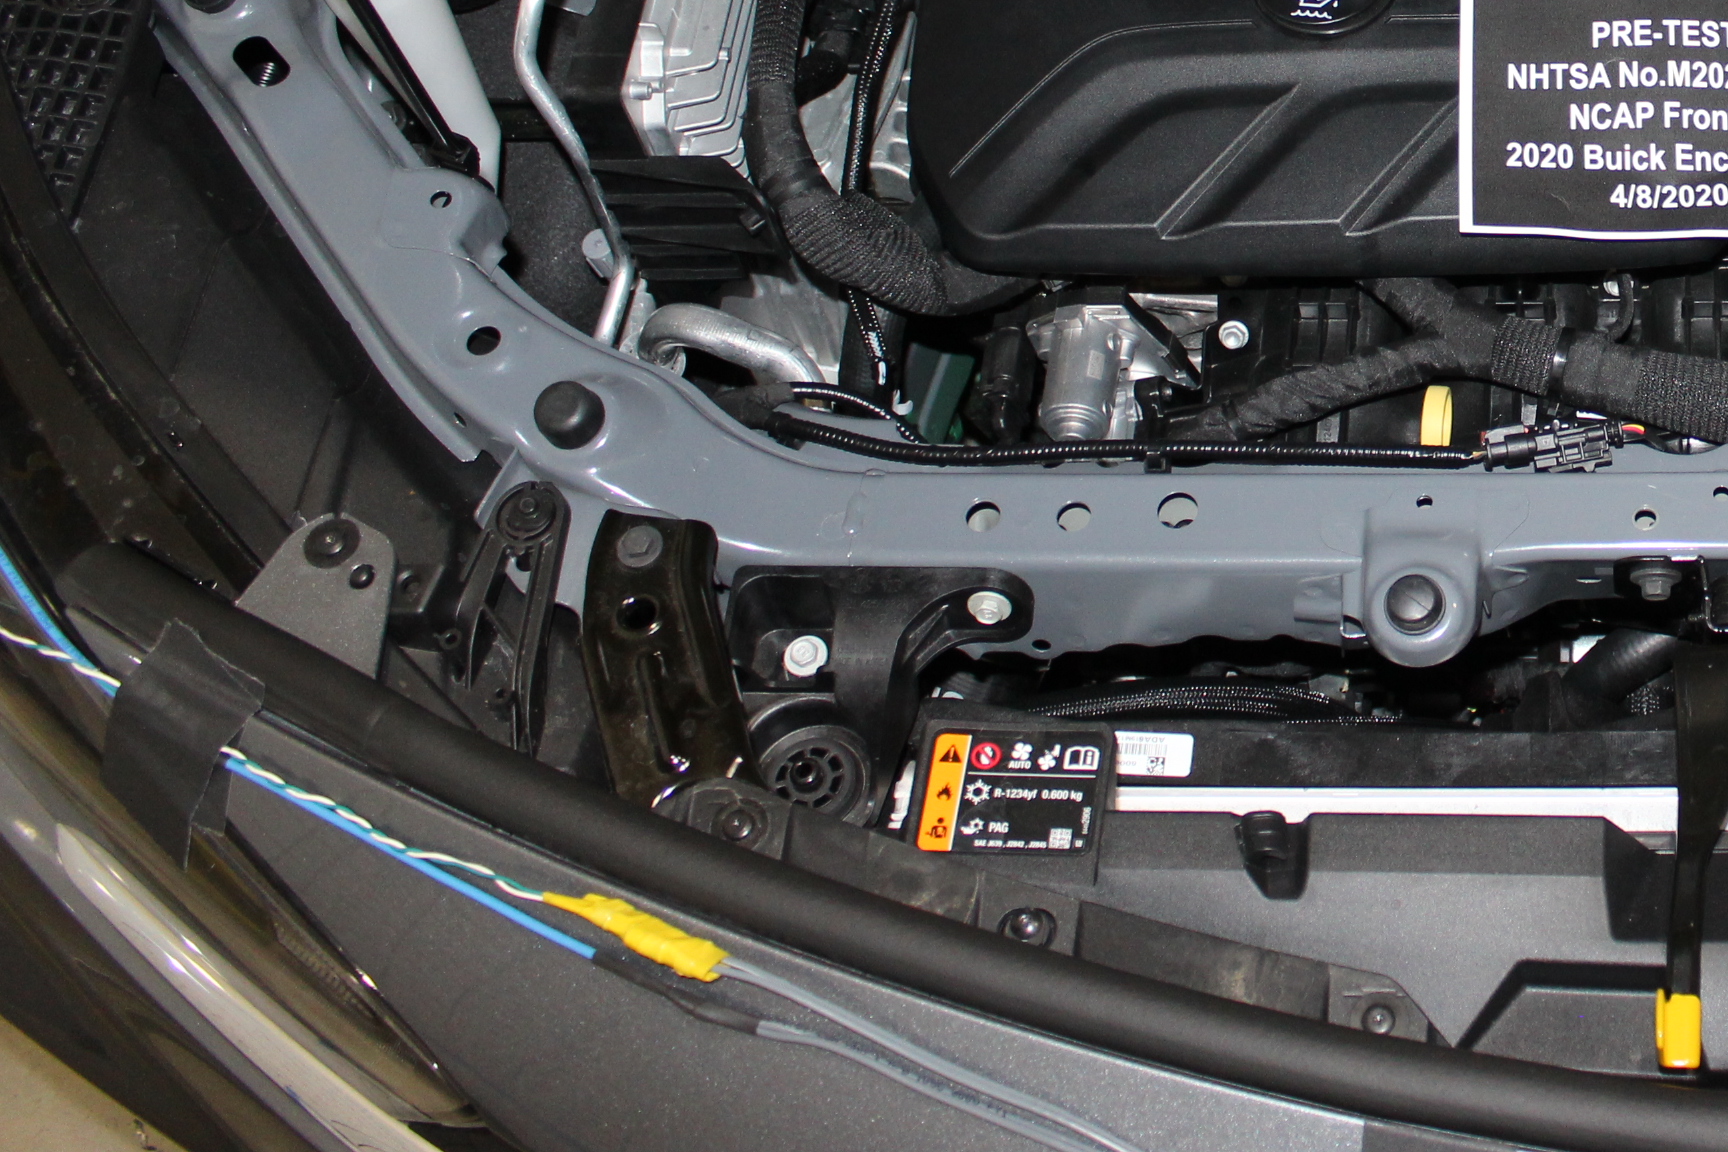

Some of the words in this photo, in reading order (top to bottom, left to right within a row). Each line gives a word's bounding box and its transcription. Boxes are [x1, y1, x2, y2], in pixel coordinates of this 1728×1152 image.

[1508, 61, 1611, 89] NHTSA
[1570, 101, 1654, 130] NCAP
[1506, 142, 1573, 169] 2020
[1584, 143, 1666, 171] Buick
[1610, 184, 1728, 208] 4/8/2020
[1008, 760, 1031, 770] AUTO
[994, 789, 1038, 800] R-1234yf
[1042, 790, 1069, 800] 0.600
[1070, 790, 1083, 802] kg
[988, 822, 1009, 834] PAG
